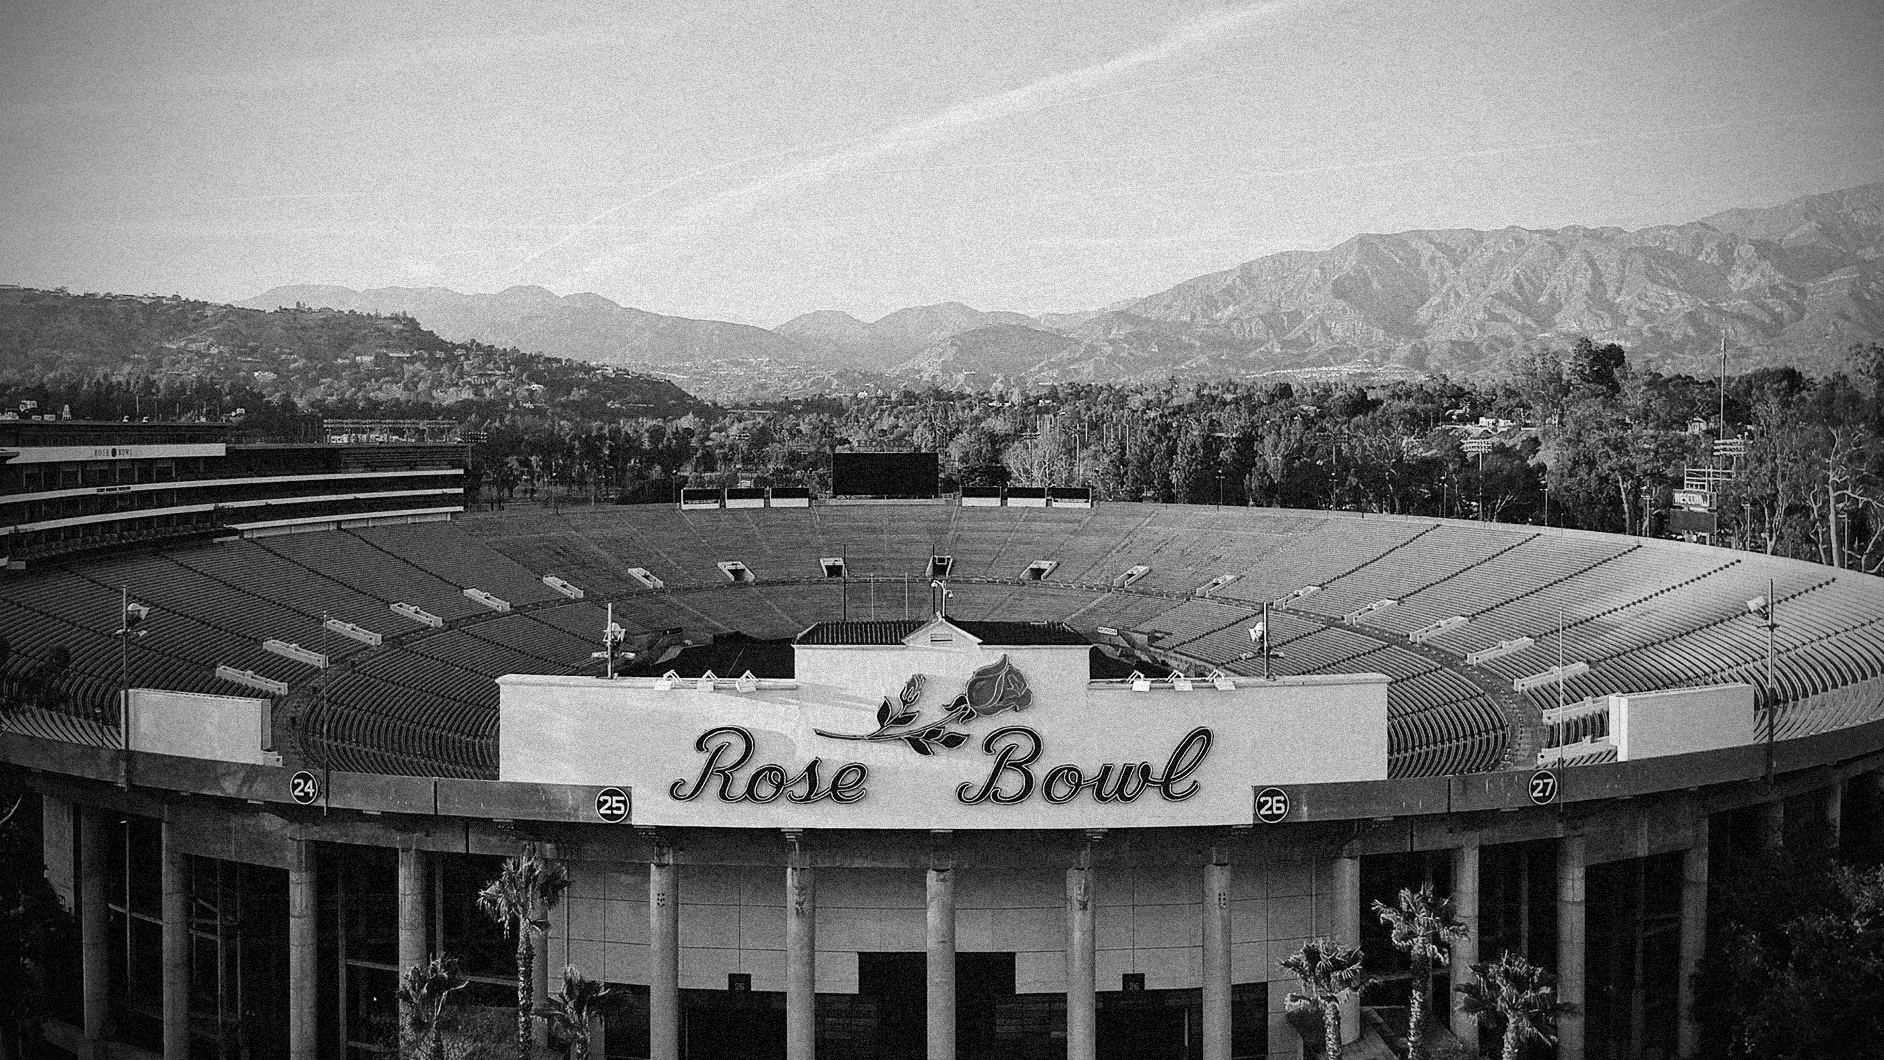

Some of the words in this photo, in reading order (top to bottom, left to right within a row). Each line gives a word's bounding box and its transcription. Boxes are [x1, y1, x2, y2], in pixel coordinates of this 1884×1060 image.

[668, 725, 868, 804] Rose
[956, 725, 1214, 805] Bowl
[294, 779, 315, 797] 24
[1532, 779, 1553, 797] 27
[599, 795, 625, 815] 25
[1259, 796, 1285, 815] 26
